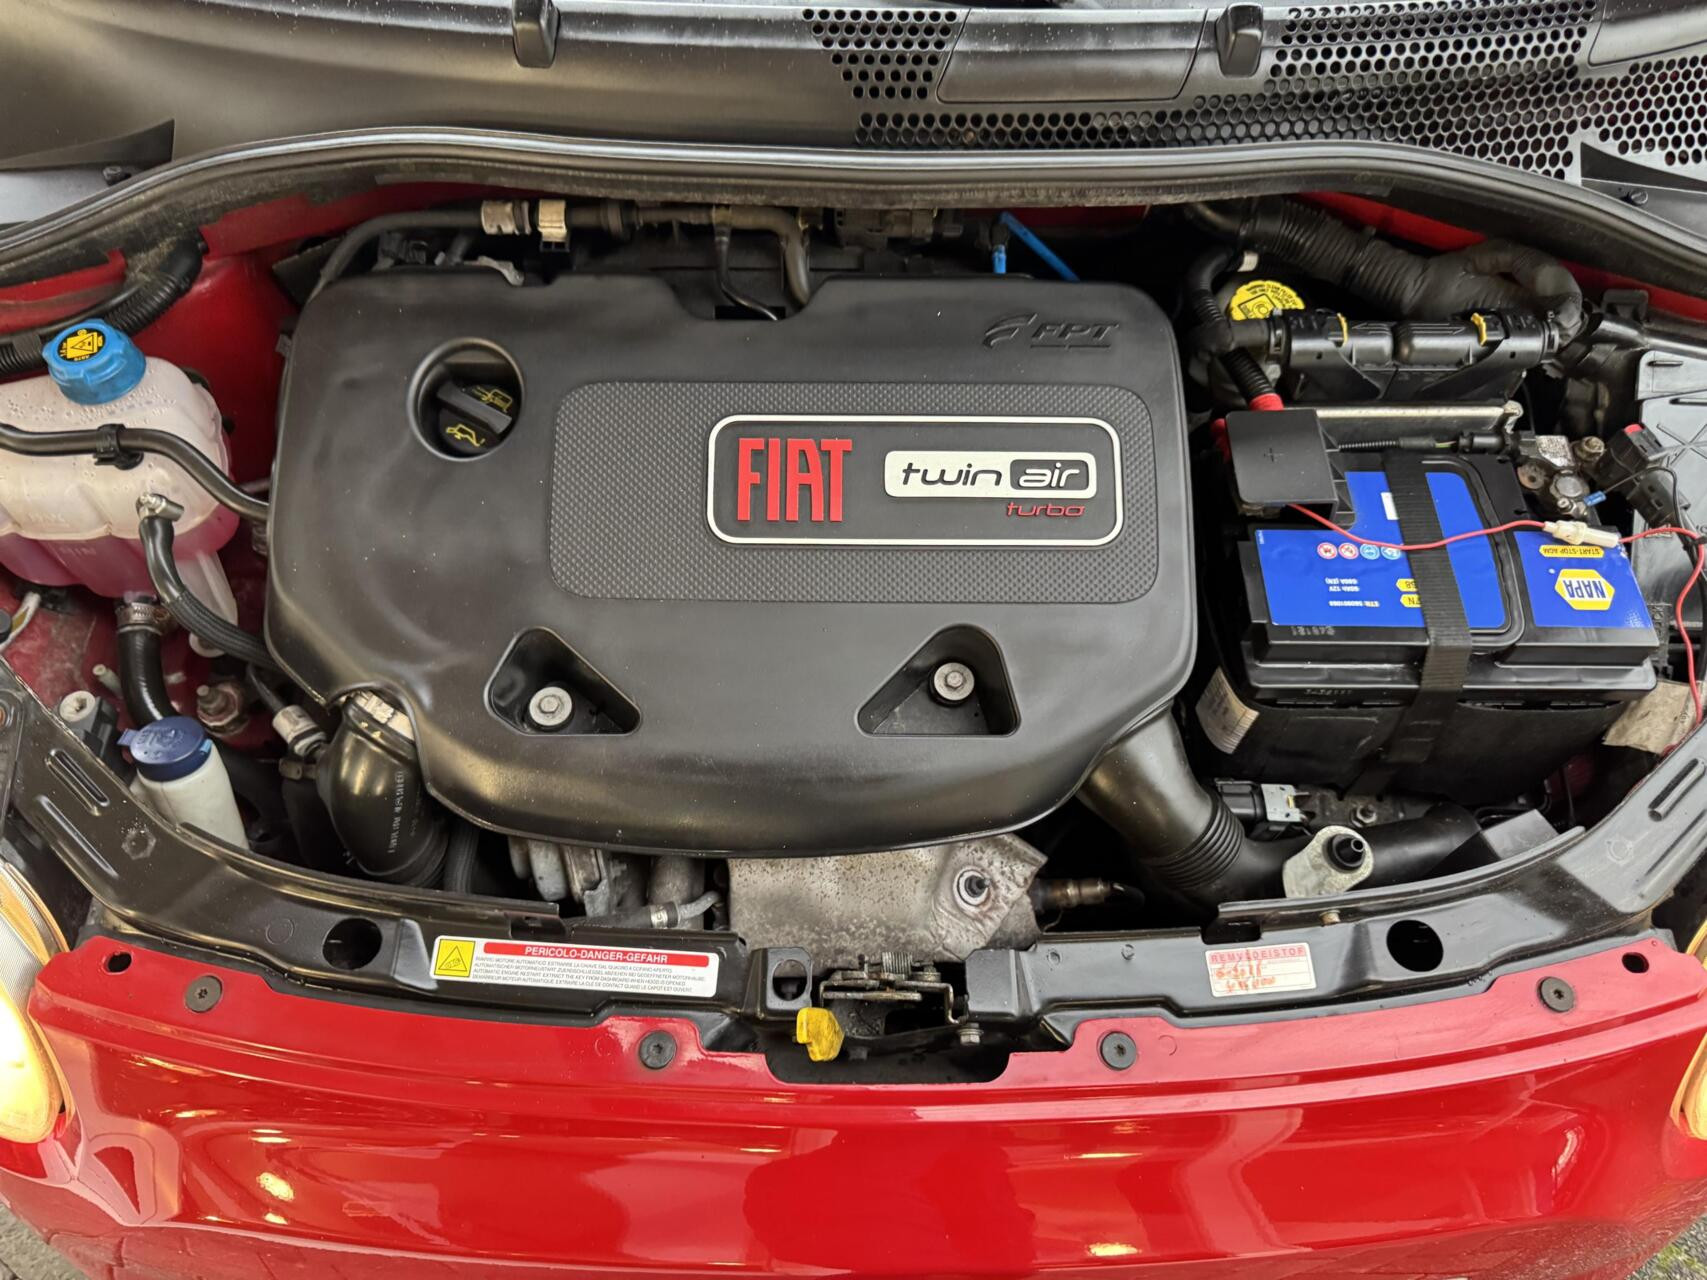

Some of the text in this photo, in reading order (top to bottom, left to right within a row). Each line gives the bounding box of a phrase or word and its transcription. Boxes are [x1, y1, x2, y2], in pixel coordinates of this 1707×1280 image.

[1031, 321, 1120, 340] FPT
[737, 437, 853, 522] FIAT
[902, 462, 1081, 488] twin air
[1006, 502, 1086, 517] turbo
[1562, 580, 1607, 599] NAPA
[524, 946, 668, 964] PERICOLO-DANGER-GEFAHR
